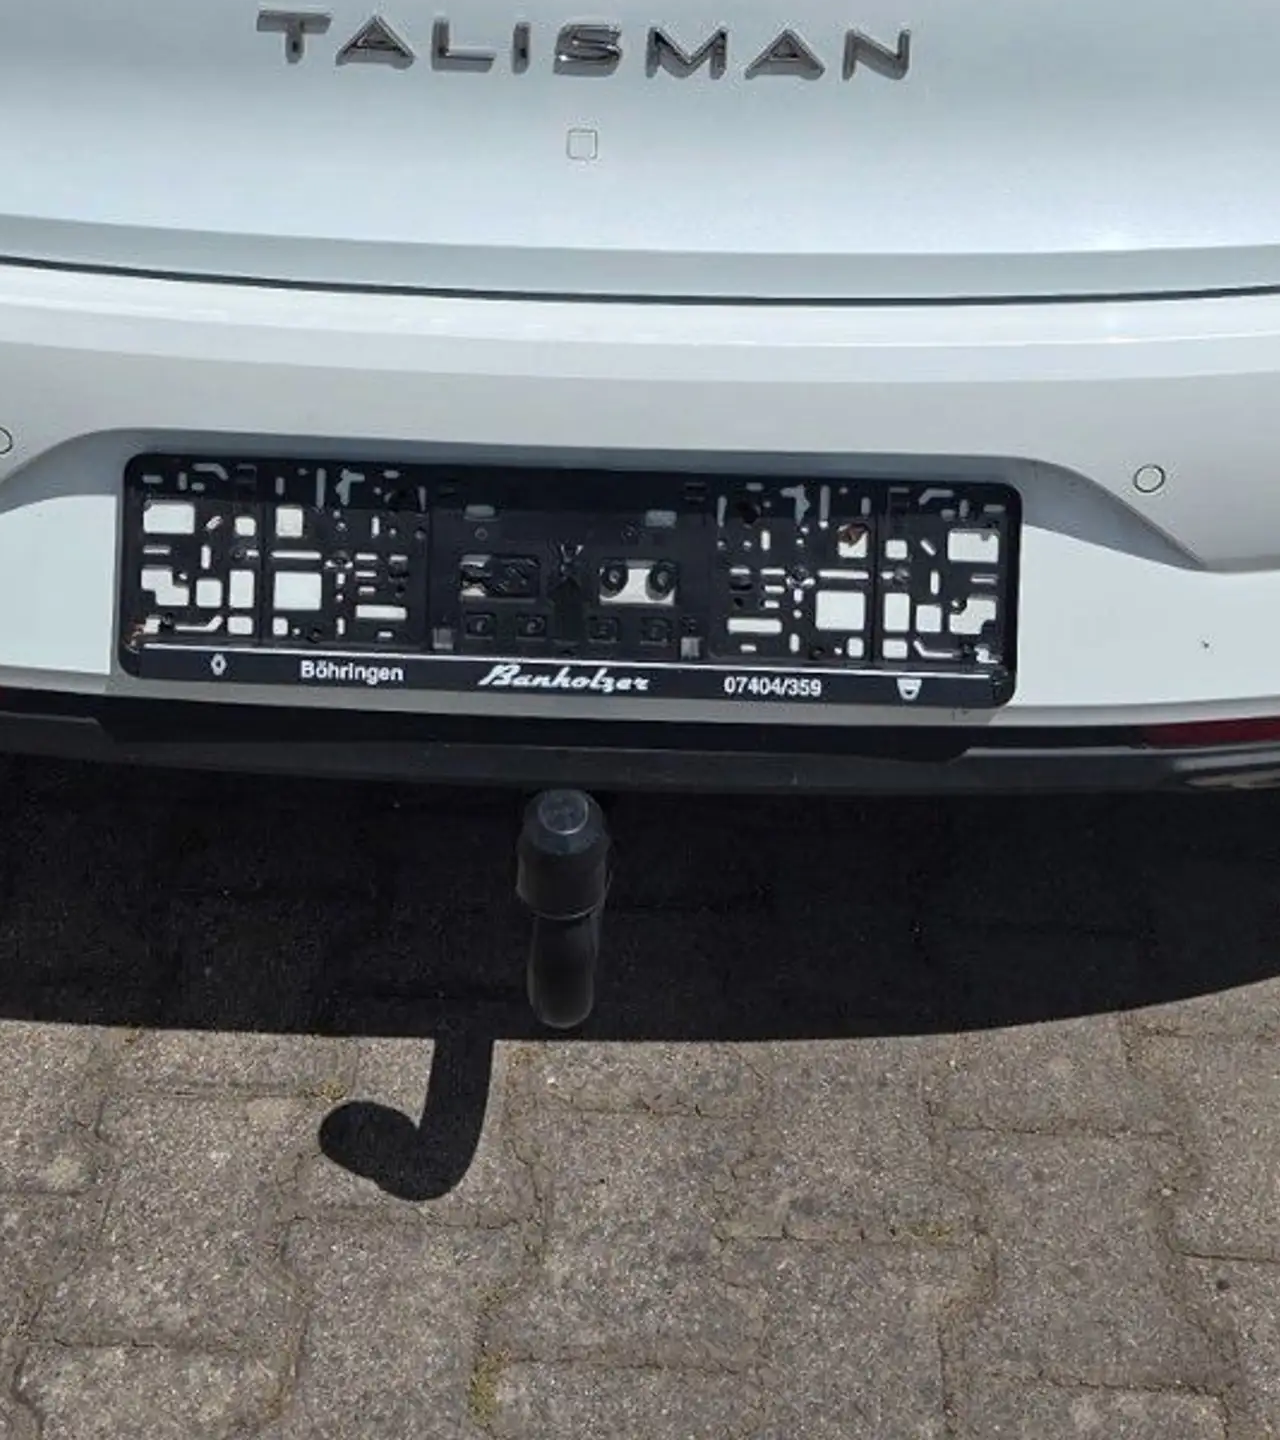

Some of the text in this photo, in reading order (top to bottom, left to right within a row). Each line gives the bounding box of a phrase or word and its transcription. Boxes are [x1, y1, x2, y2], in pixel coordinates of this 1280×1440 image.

[257, 8, 912, 81] TALISMAN
[300, 660, 822, 696] Böhringen Banholzer 07404/359
